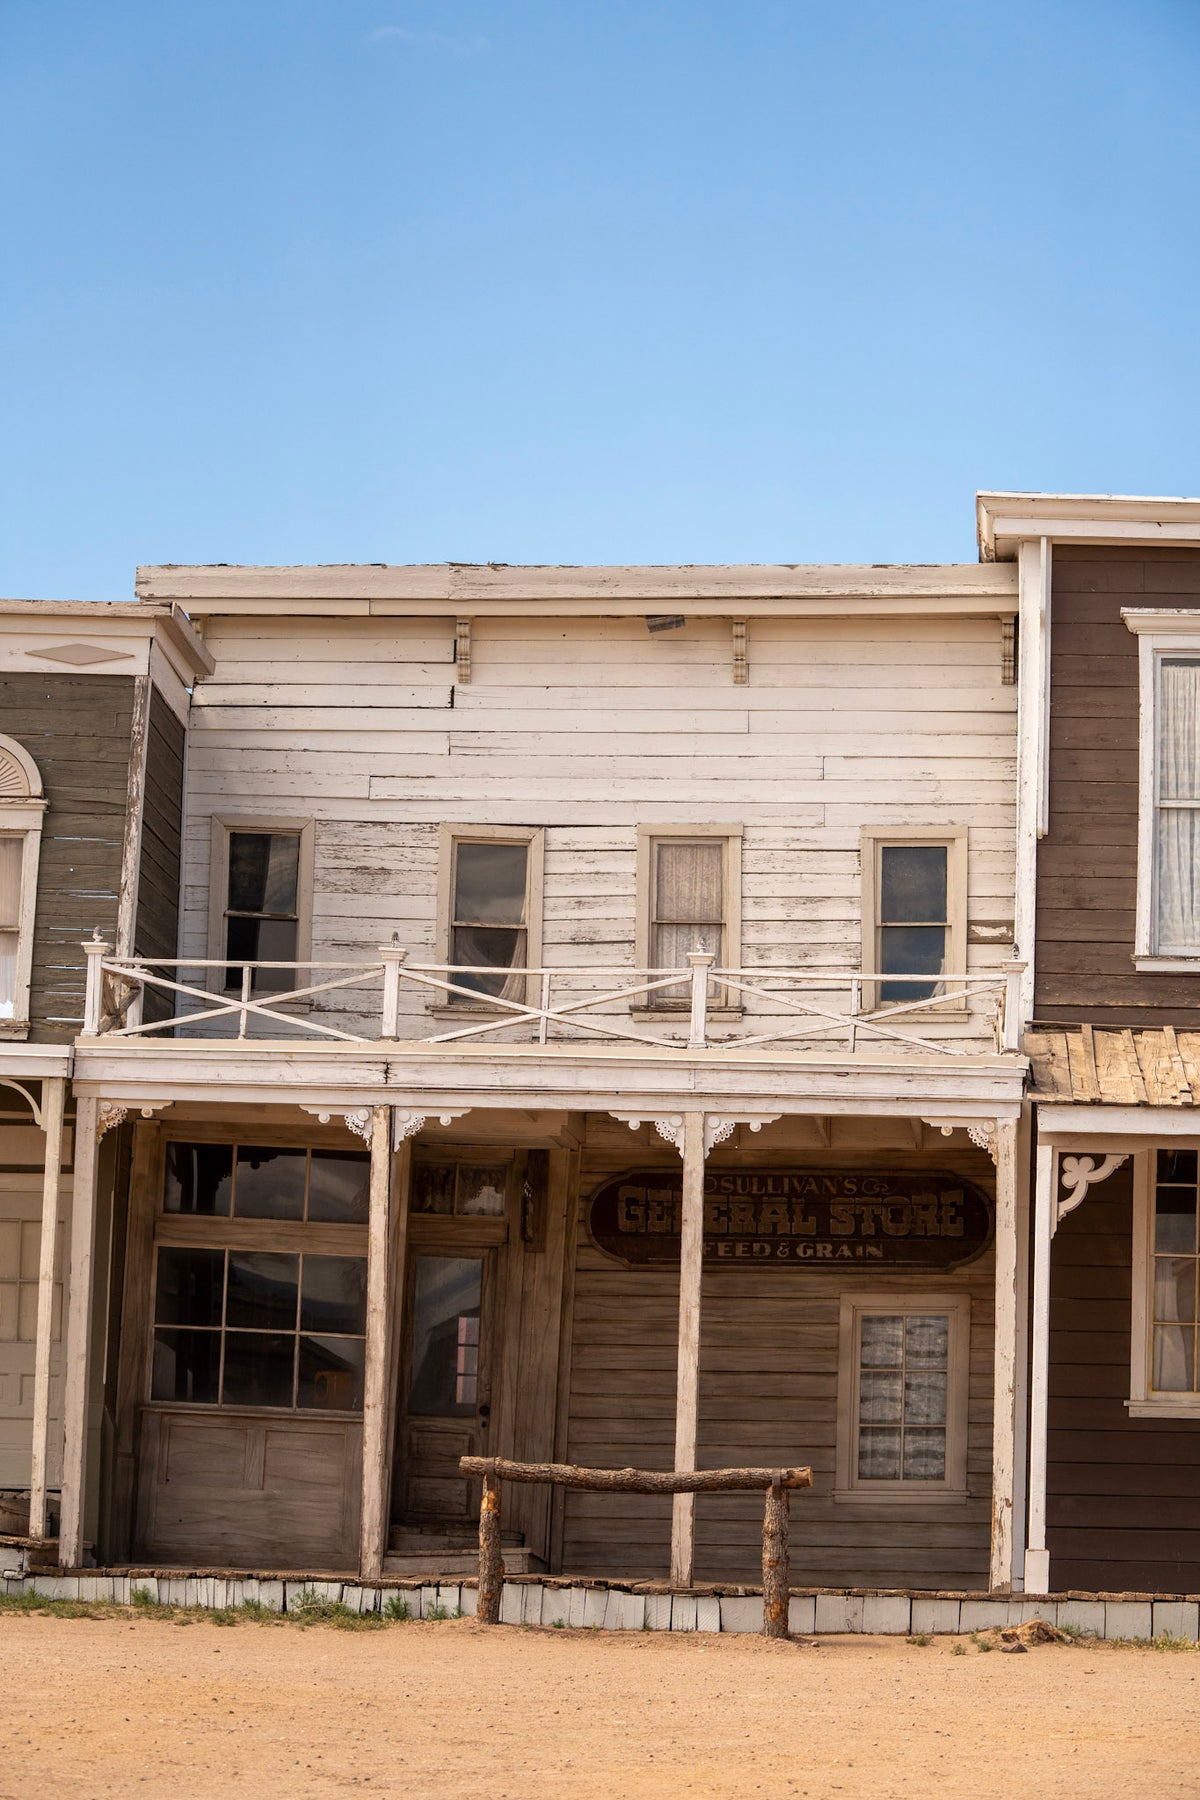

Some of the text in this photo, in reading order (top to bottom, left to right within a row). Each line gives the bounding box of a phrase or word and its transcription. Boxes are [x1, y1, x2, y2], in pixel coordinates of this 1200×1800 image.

[829, 1189, 965, 1237] STORE
[703, 1242, 772, 1258] FEED
[796, 1242, 884, 1259] GRAIN
